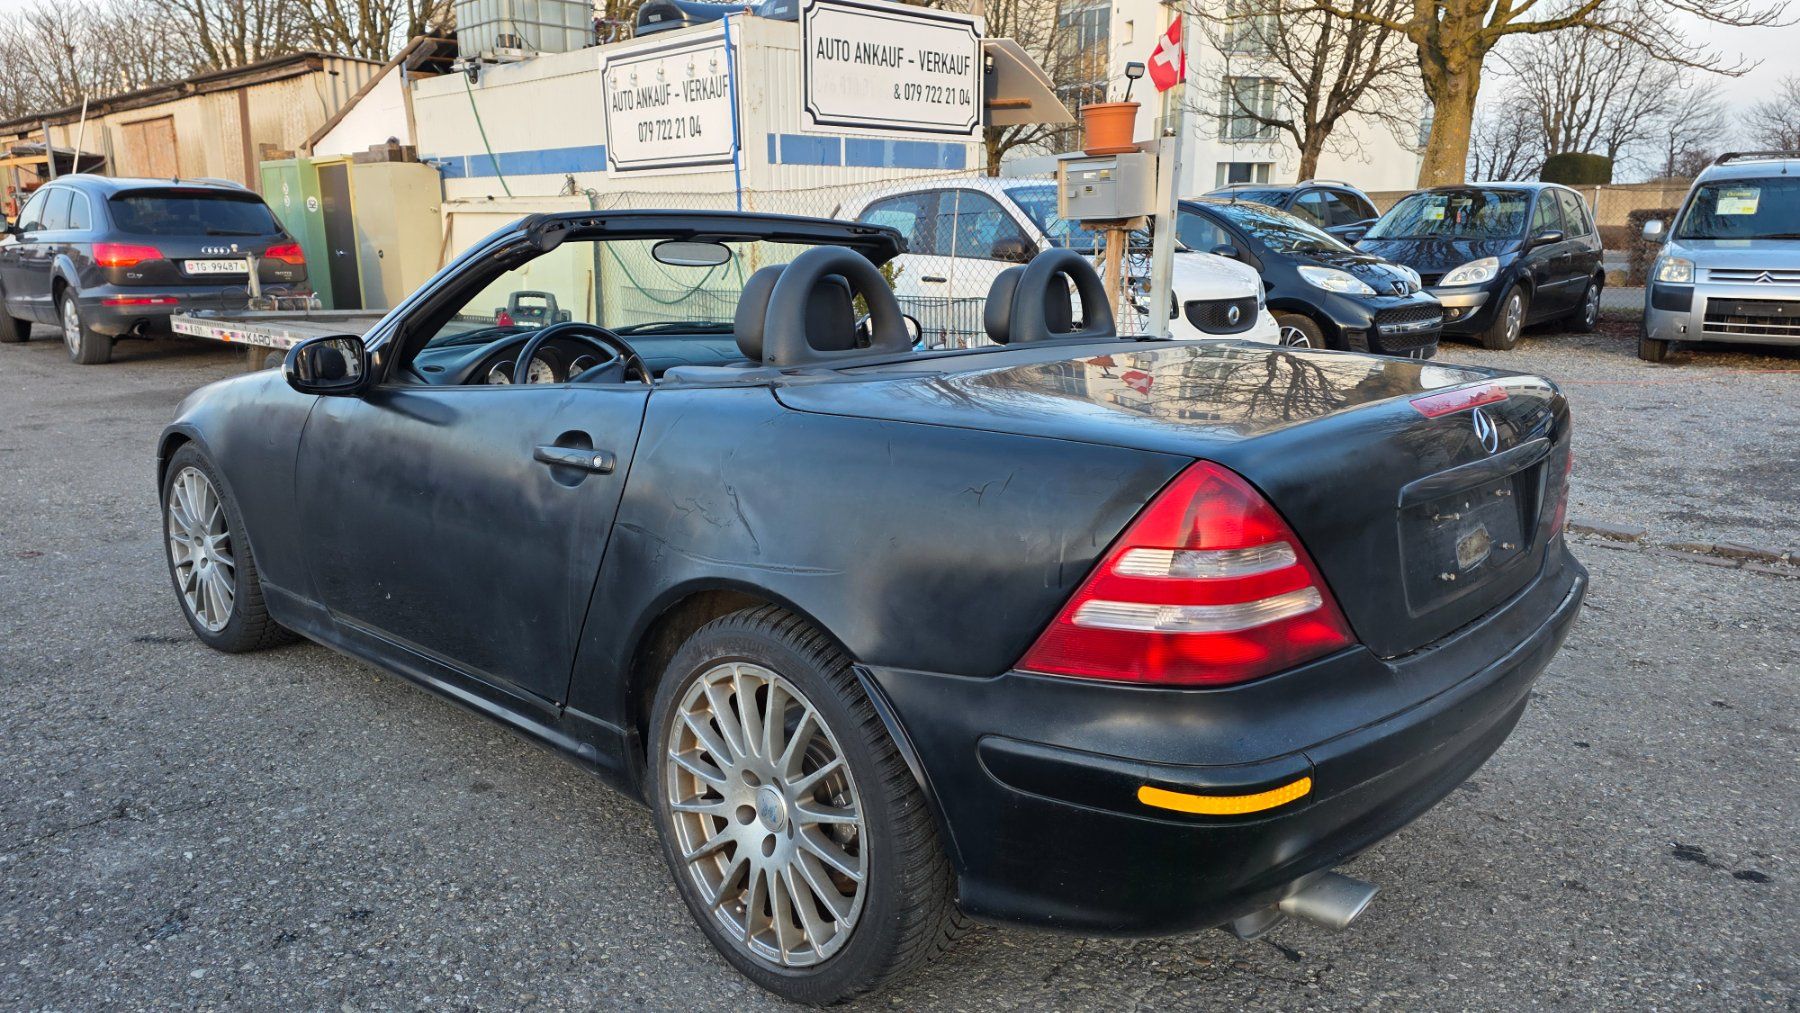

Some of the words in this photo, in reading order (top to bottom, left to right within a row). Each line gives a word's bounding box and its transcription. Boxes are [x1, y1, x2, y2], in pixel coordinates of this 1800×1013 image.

[816, 37, 850, 62] AUTO
[854, 42, 904, 68] ANKAUF
[919, 50, 971, 76] VERKAUF
[612, 90, 633, 112] AUTO
[636, 83, 671, 110] ANKAUF
[682, 74, 728, 103] VERKAUF
[894, 83, 901, 100] &
[904, 83, 922, 102] 079
[925, 85, 942, 104] 722
[945, 87, 956, 105] 21
[959, 88, 971, 106] 04
[638, 121, 653, 142] 079
[656, 118, 673, 141] 722
[675, 117, 686, 139] 21
[689, 115, 702, 138] 04
[195, 262, 206, 271] TG
